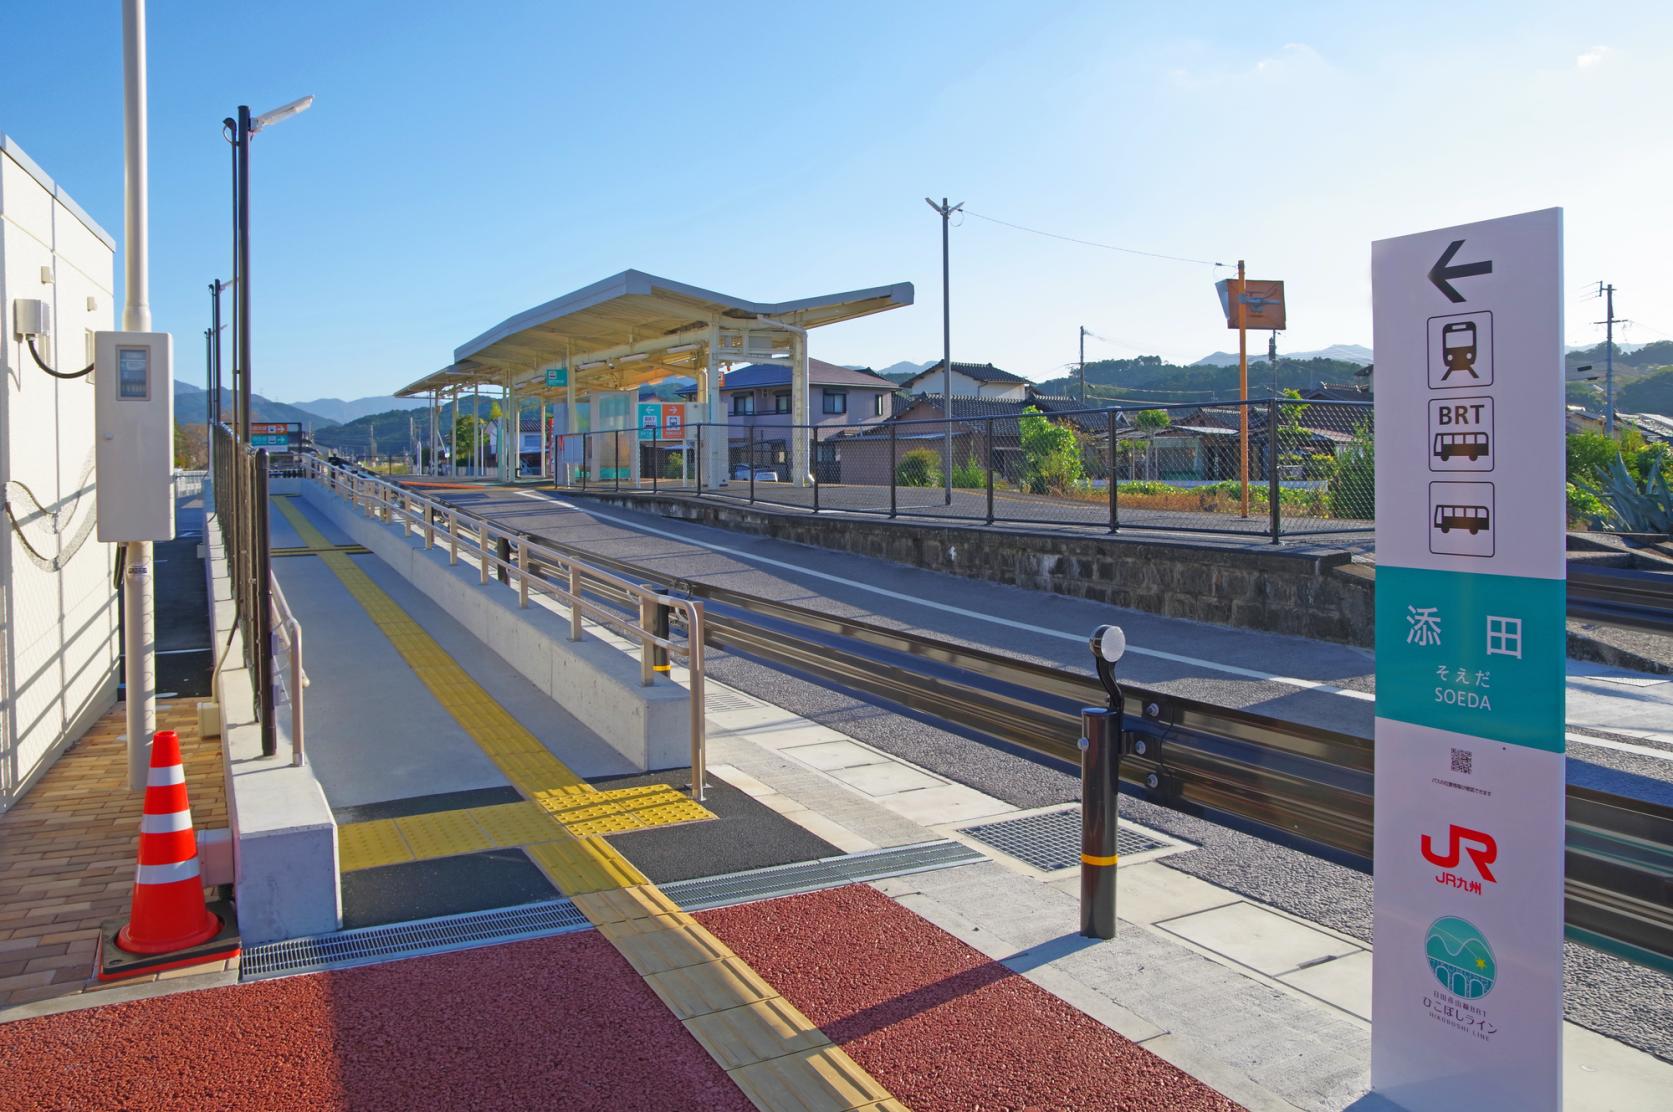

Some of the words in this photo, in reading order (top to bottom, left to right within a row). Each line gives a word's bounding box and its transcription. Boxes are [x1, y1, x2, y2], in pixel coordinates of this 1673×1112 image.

[1439, 404, 1485, 426] BRT
[1436, 665, 1491, 688] そえだ
[1434, 687, 1492, 712] SOEDA
[1421, 824, 1497, 883] JR
[1435, 871, 1482, 896] JR九州
[1423, 996, 1498, 1034] ひこぼしライン
